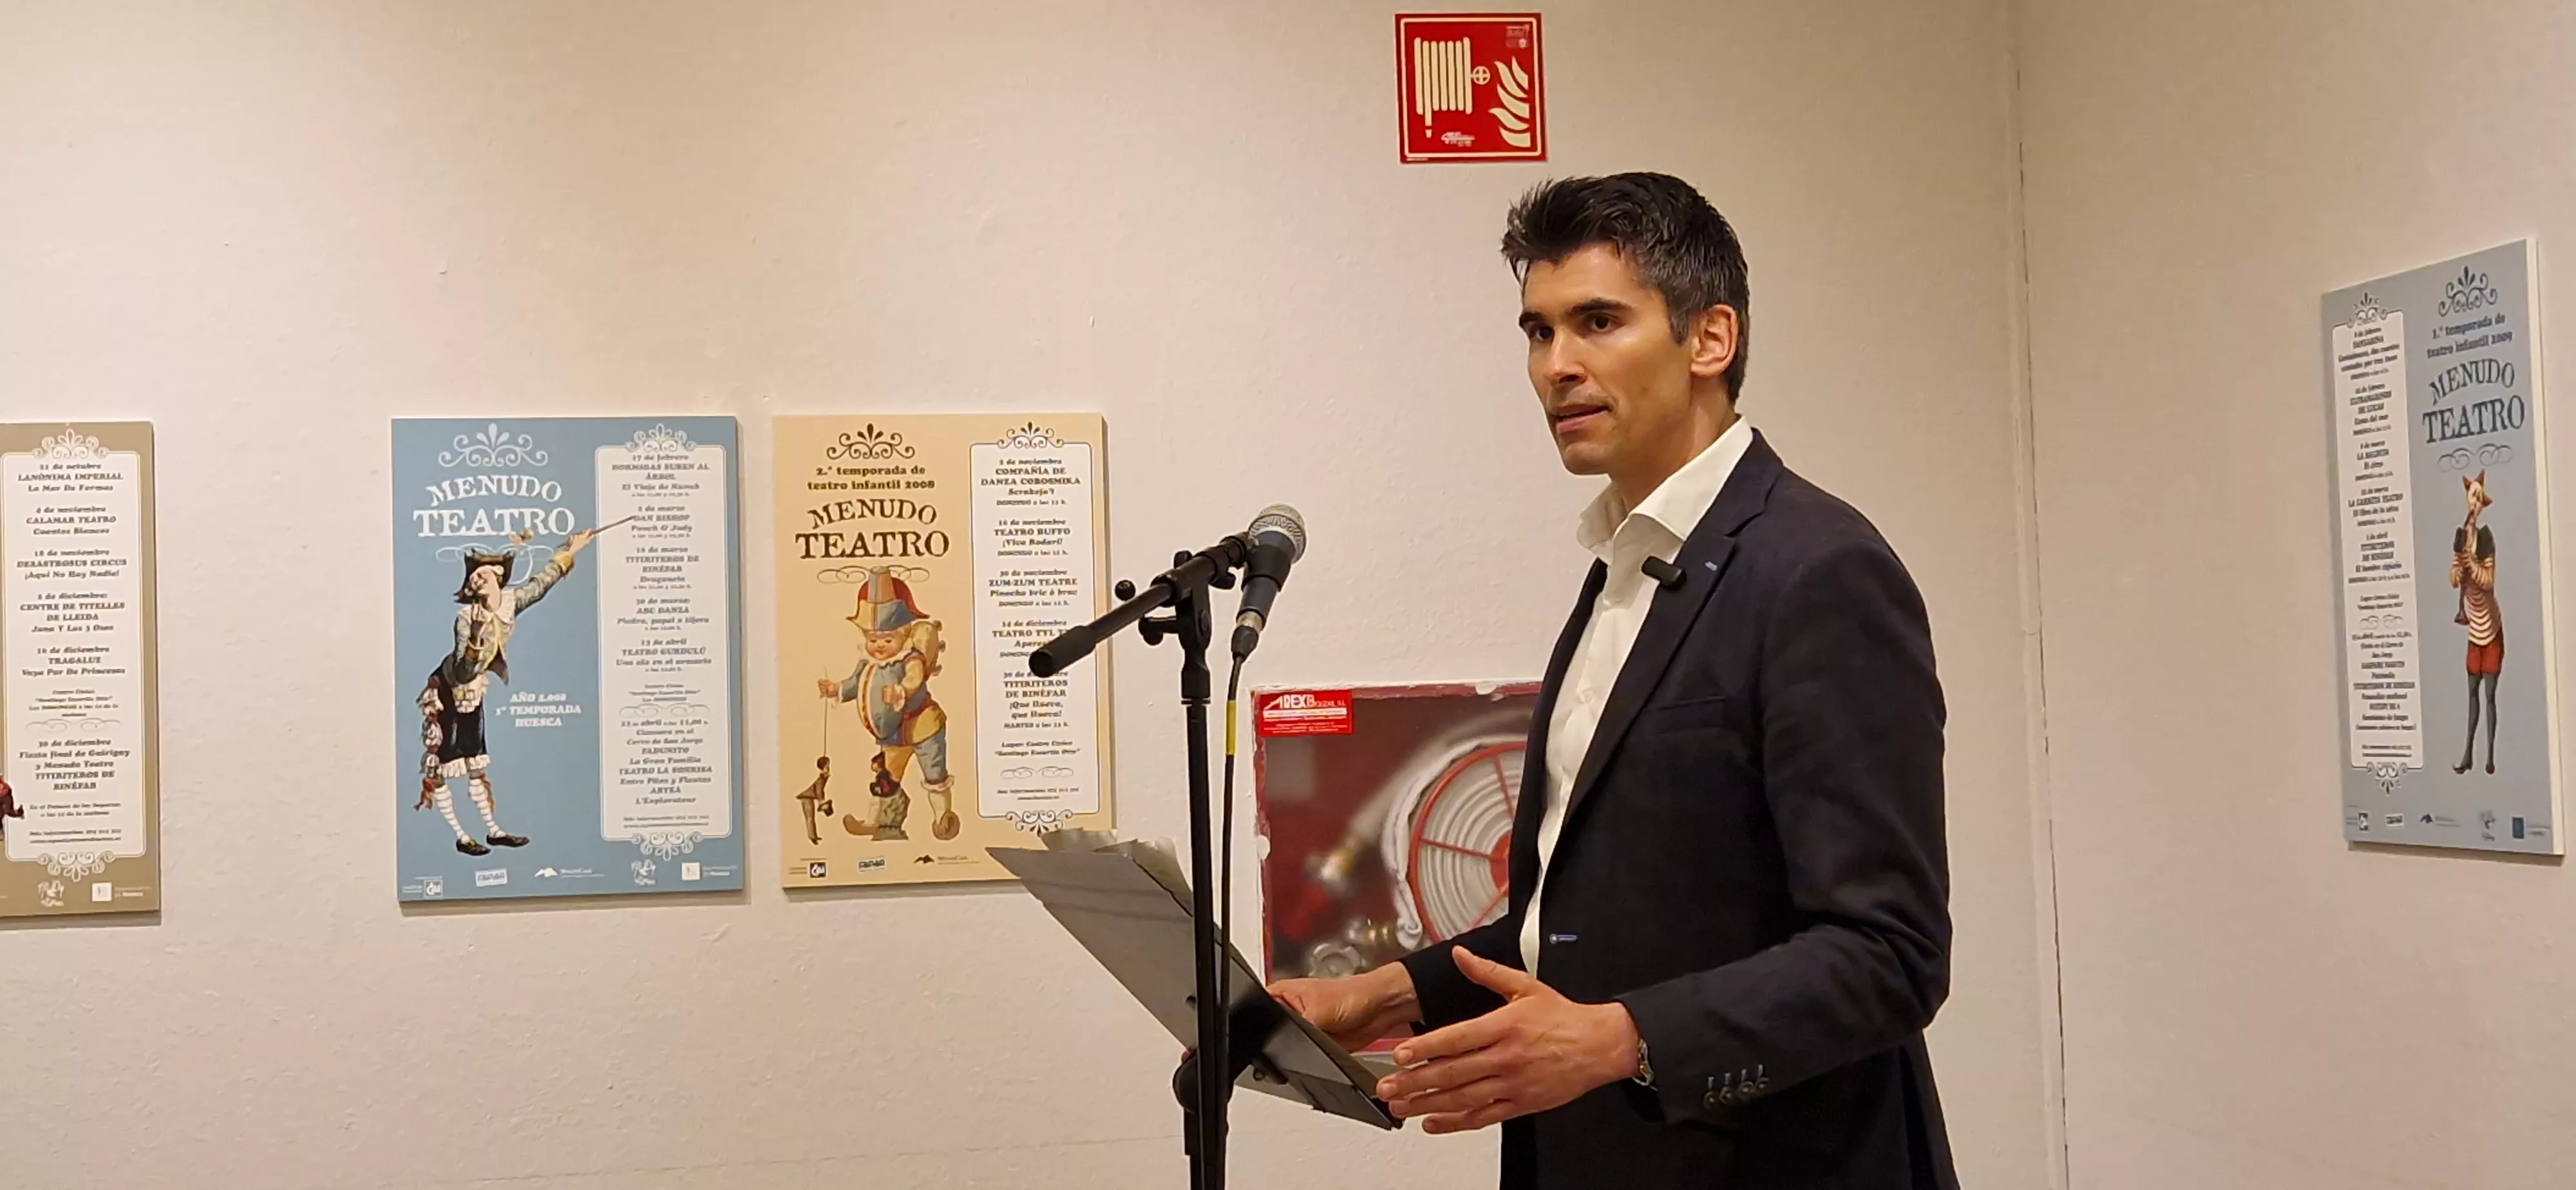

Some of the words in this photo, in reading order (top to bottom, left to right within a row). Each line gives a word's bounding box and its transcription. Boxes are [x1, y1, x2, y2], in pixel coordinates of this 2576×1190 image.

[2445, 317, 2492, 337] temporada
[2495, 312, 2505, 325] de
[2427, 343, 2453, 359] teatro
[2455, 335, 2489, 353] infantil
[2491, 331, 2513, 345] 2009
[2429, 358, 2515, 406] MENUDO
[2422, 395, 2525, 444] TEATRO
[837, 466, 907, 477] temporada
[911, 465, 925, 475] de
[996, 466, 1049, 475] COMPAÑÍA
[807, 481, 848, 490] teatro
[851, 480, 901, 489] infantil
[905, 480, 934, 489] 2008
[426, 475, 562, 507] MENUDO
[808, 498, 938, 529] MENUDO
[413, 507, 576, 537] TEATRO
[795, 531, 950, 559] TEATRO
[509, 692, 536, 703] AÑO
[1023, 689, 1066, 697] BINÉFAR
[509, 704, 582, 715] TEMPORADA
[515, 717, 562, 727] HUESCA
[51, 751, 72, 759] final
[36, 771, 99, 780] TITIRITEROS
[53, 782, 96, 790] BINÉFAR
